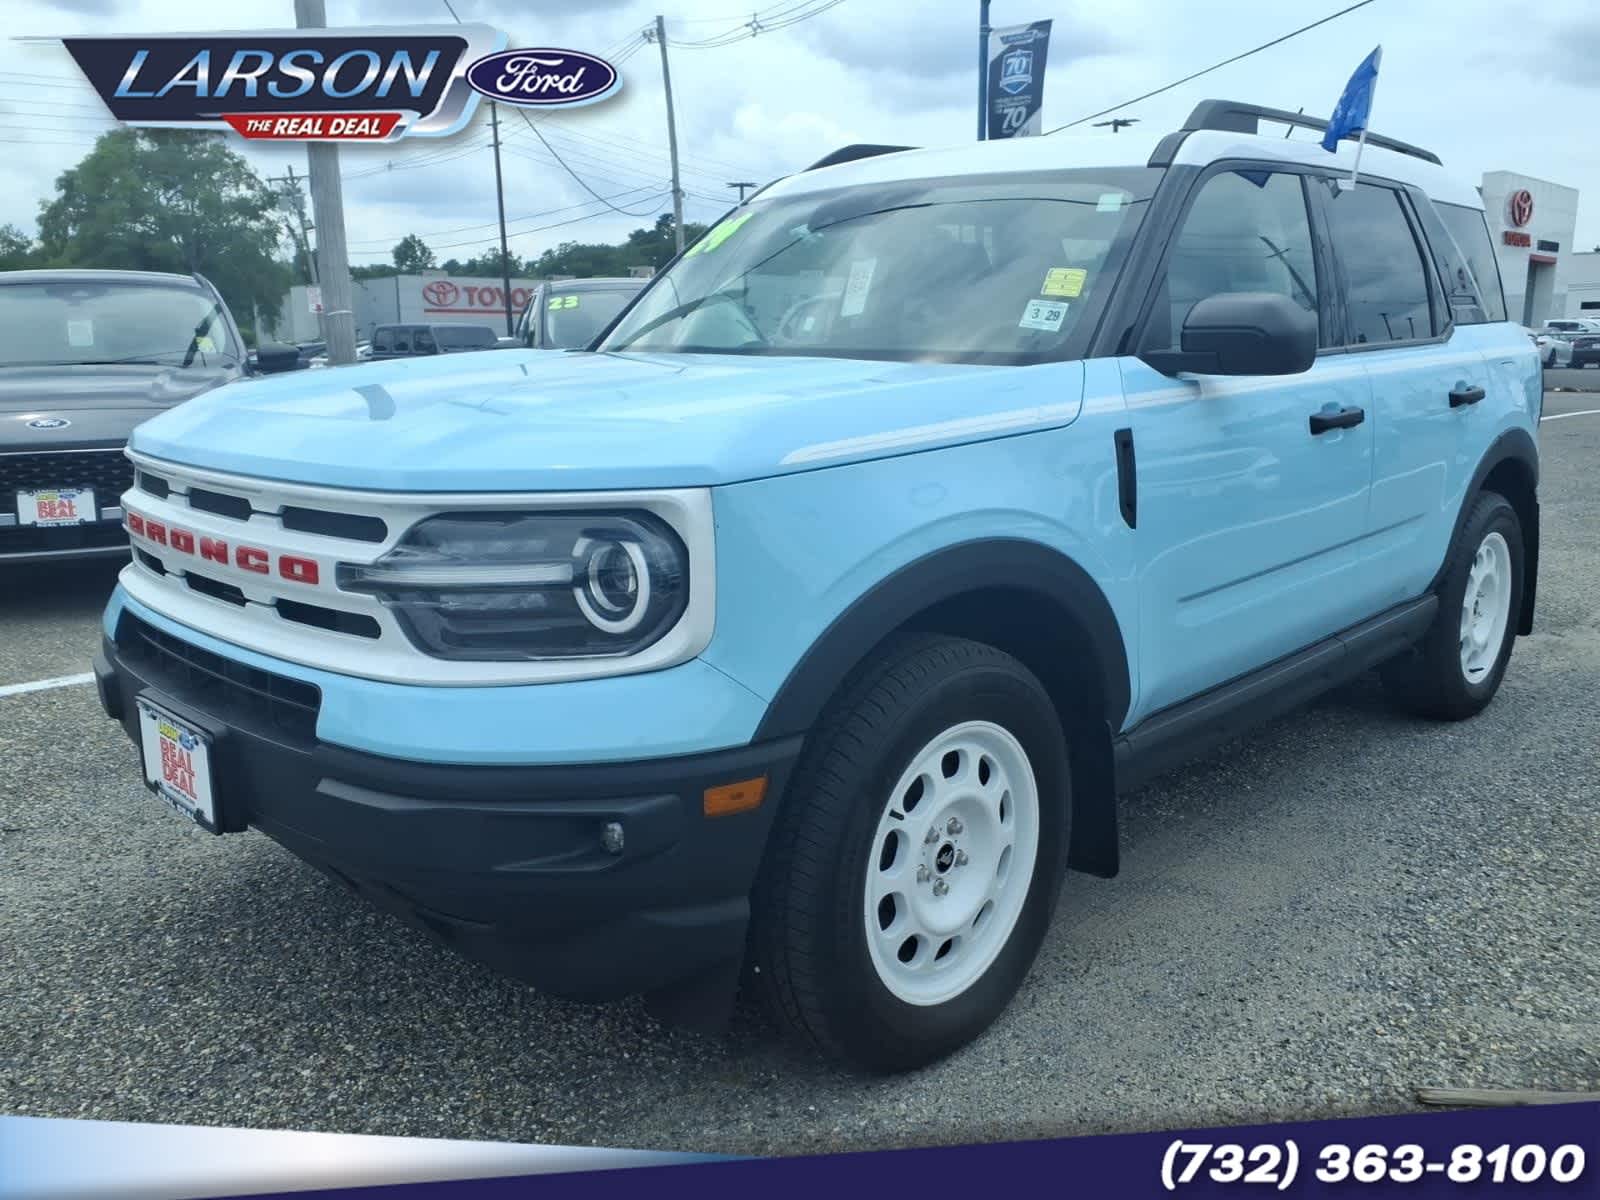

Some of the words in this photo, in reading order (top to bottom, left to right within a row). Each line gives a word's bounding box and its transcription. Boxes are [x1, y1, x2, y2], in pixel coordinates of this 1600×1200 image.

[1006, 57, 1027, 77] 70
[1002, 106, 1027, 129] 70
[549, 295, 578, 310] 23
[127, 512, 320, 585] BRONCO
[160, 737, 195, 777] REAL
[163, 759, 198, 800] DEAL
